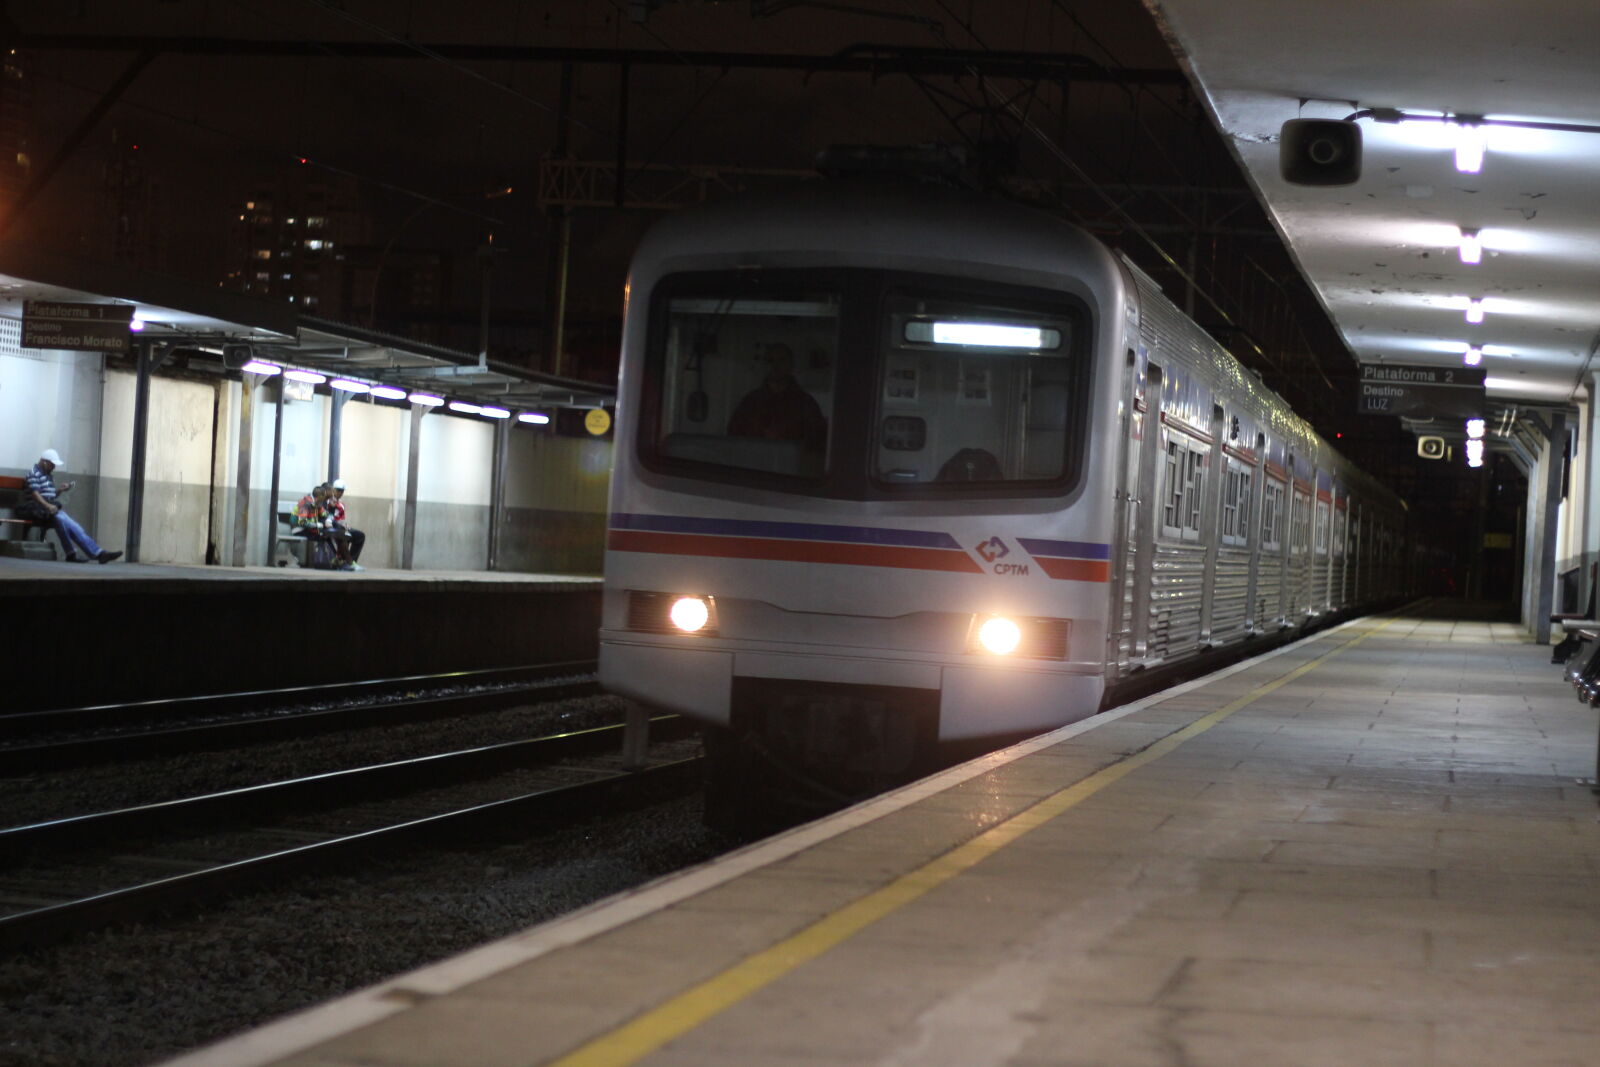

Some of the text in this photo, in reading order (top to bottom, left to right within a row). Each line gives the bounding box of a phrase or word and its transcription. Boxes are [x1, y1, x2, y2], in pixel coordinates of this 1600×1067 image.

[27, 304, 104, 319] Plataforma 1
[27, 321, 62, 332] Destino
[25, 333, 123, 348] Francisco Morato
[1364, 366, 1454, 383] Plataforma 2
[1363, 385, 1404, 397] Destino
[1367, 397, 1388, 410] LUZ
[994, 563, 1029, 576] CPTM
